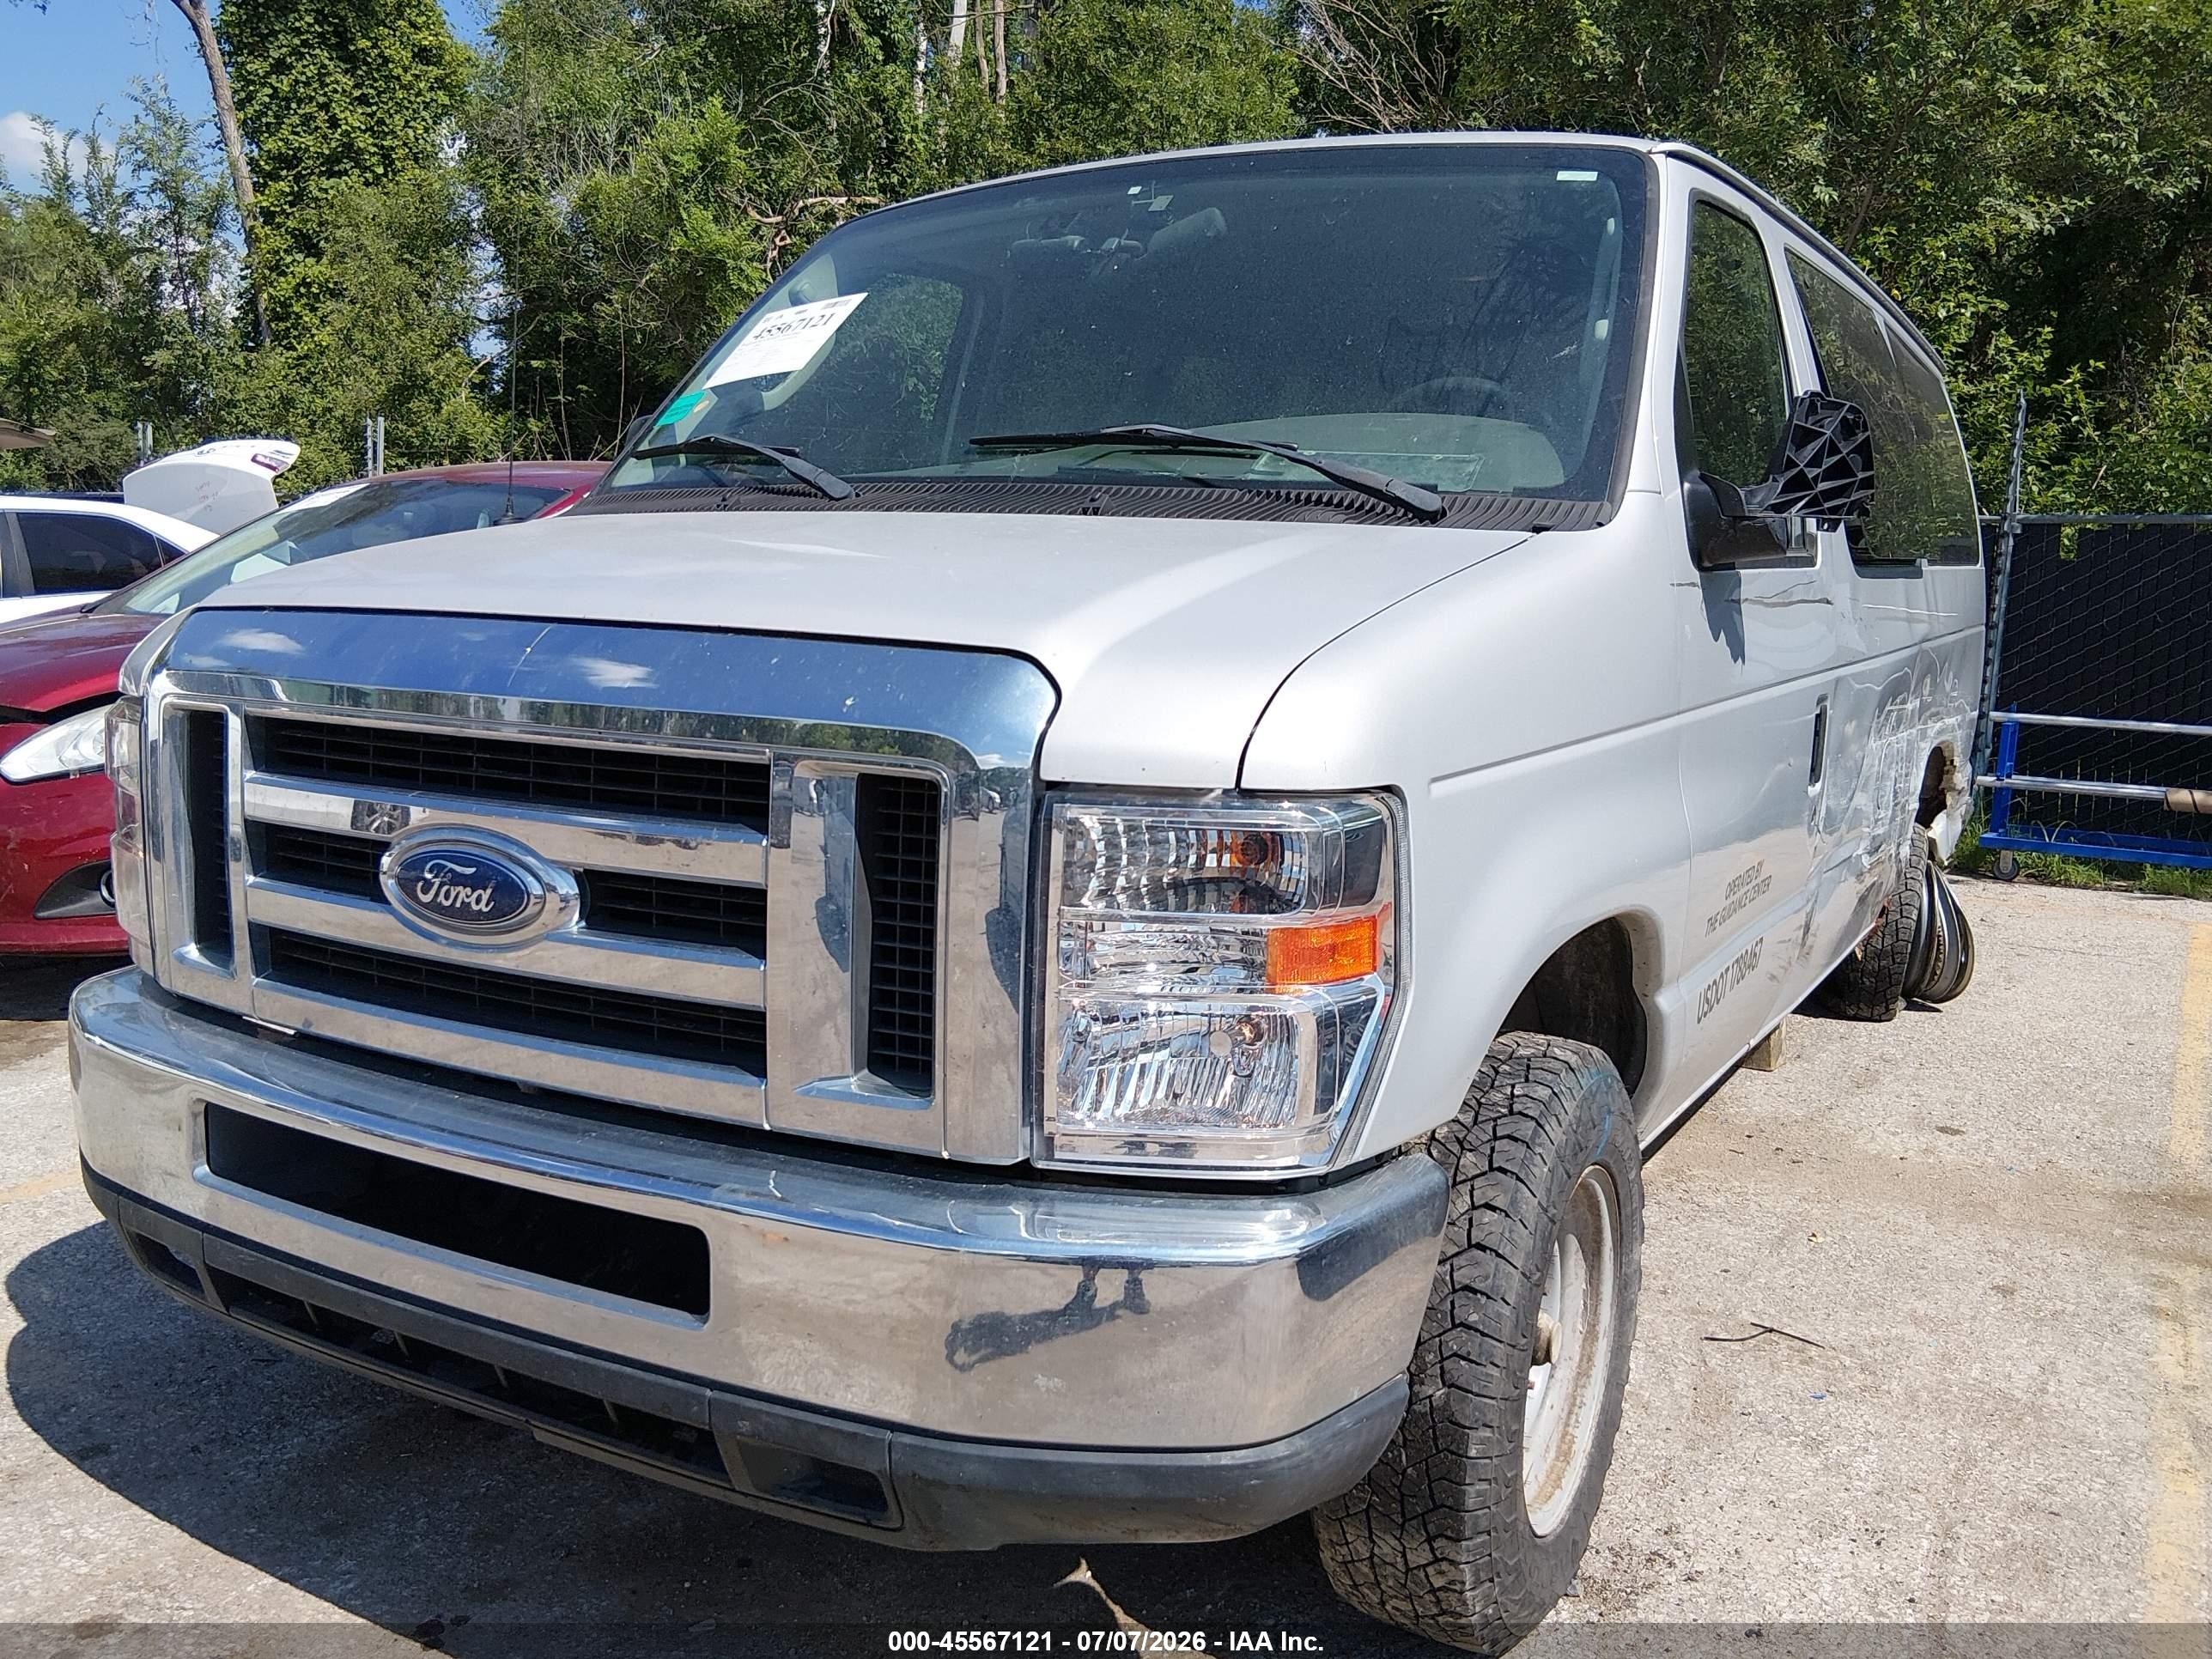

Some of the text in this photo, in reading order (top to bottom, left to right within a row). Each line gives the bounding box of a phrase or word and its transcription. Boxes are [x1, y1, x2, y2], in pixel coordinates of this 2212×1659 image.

[753, 313, 836, 340] 45567121
[416, 859, 495, 912] Ford
[1705, 874, 1772, 938] THE GUIDANCE CENTER
[1724, 859, 1765, 901] OPERATED BY
[1697, 936, 1764, 1024] USDOT 1788467
